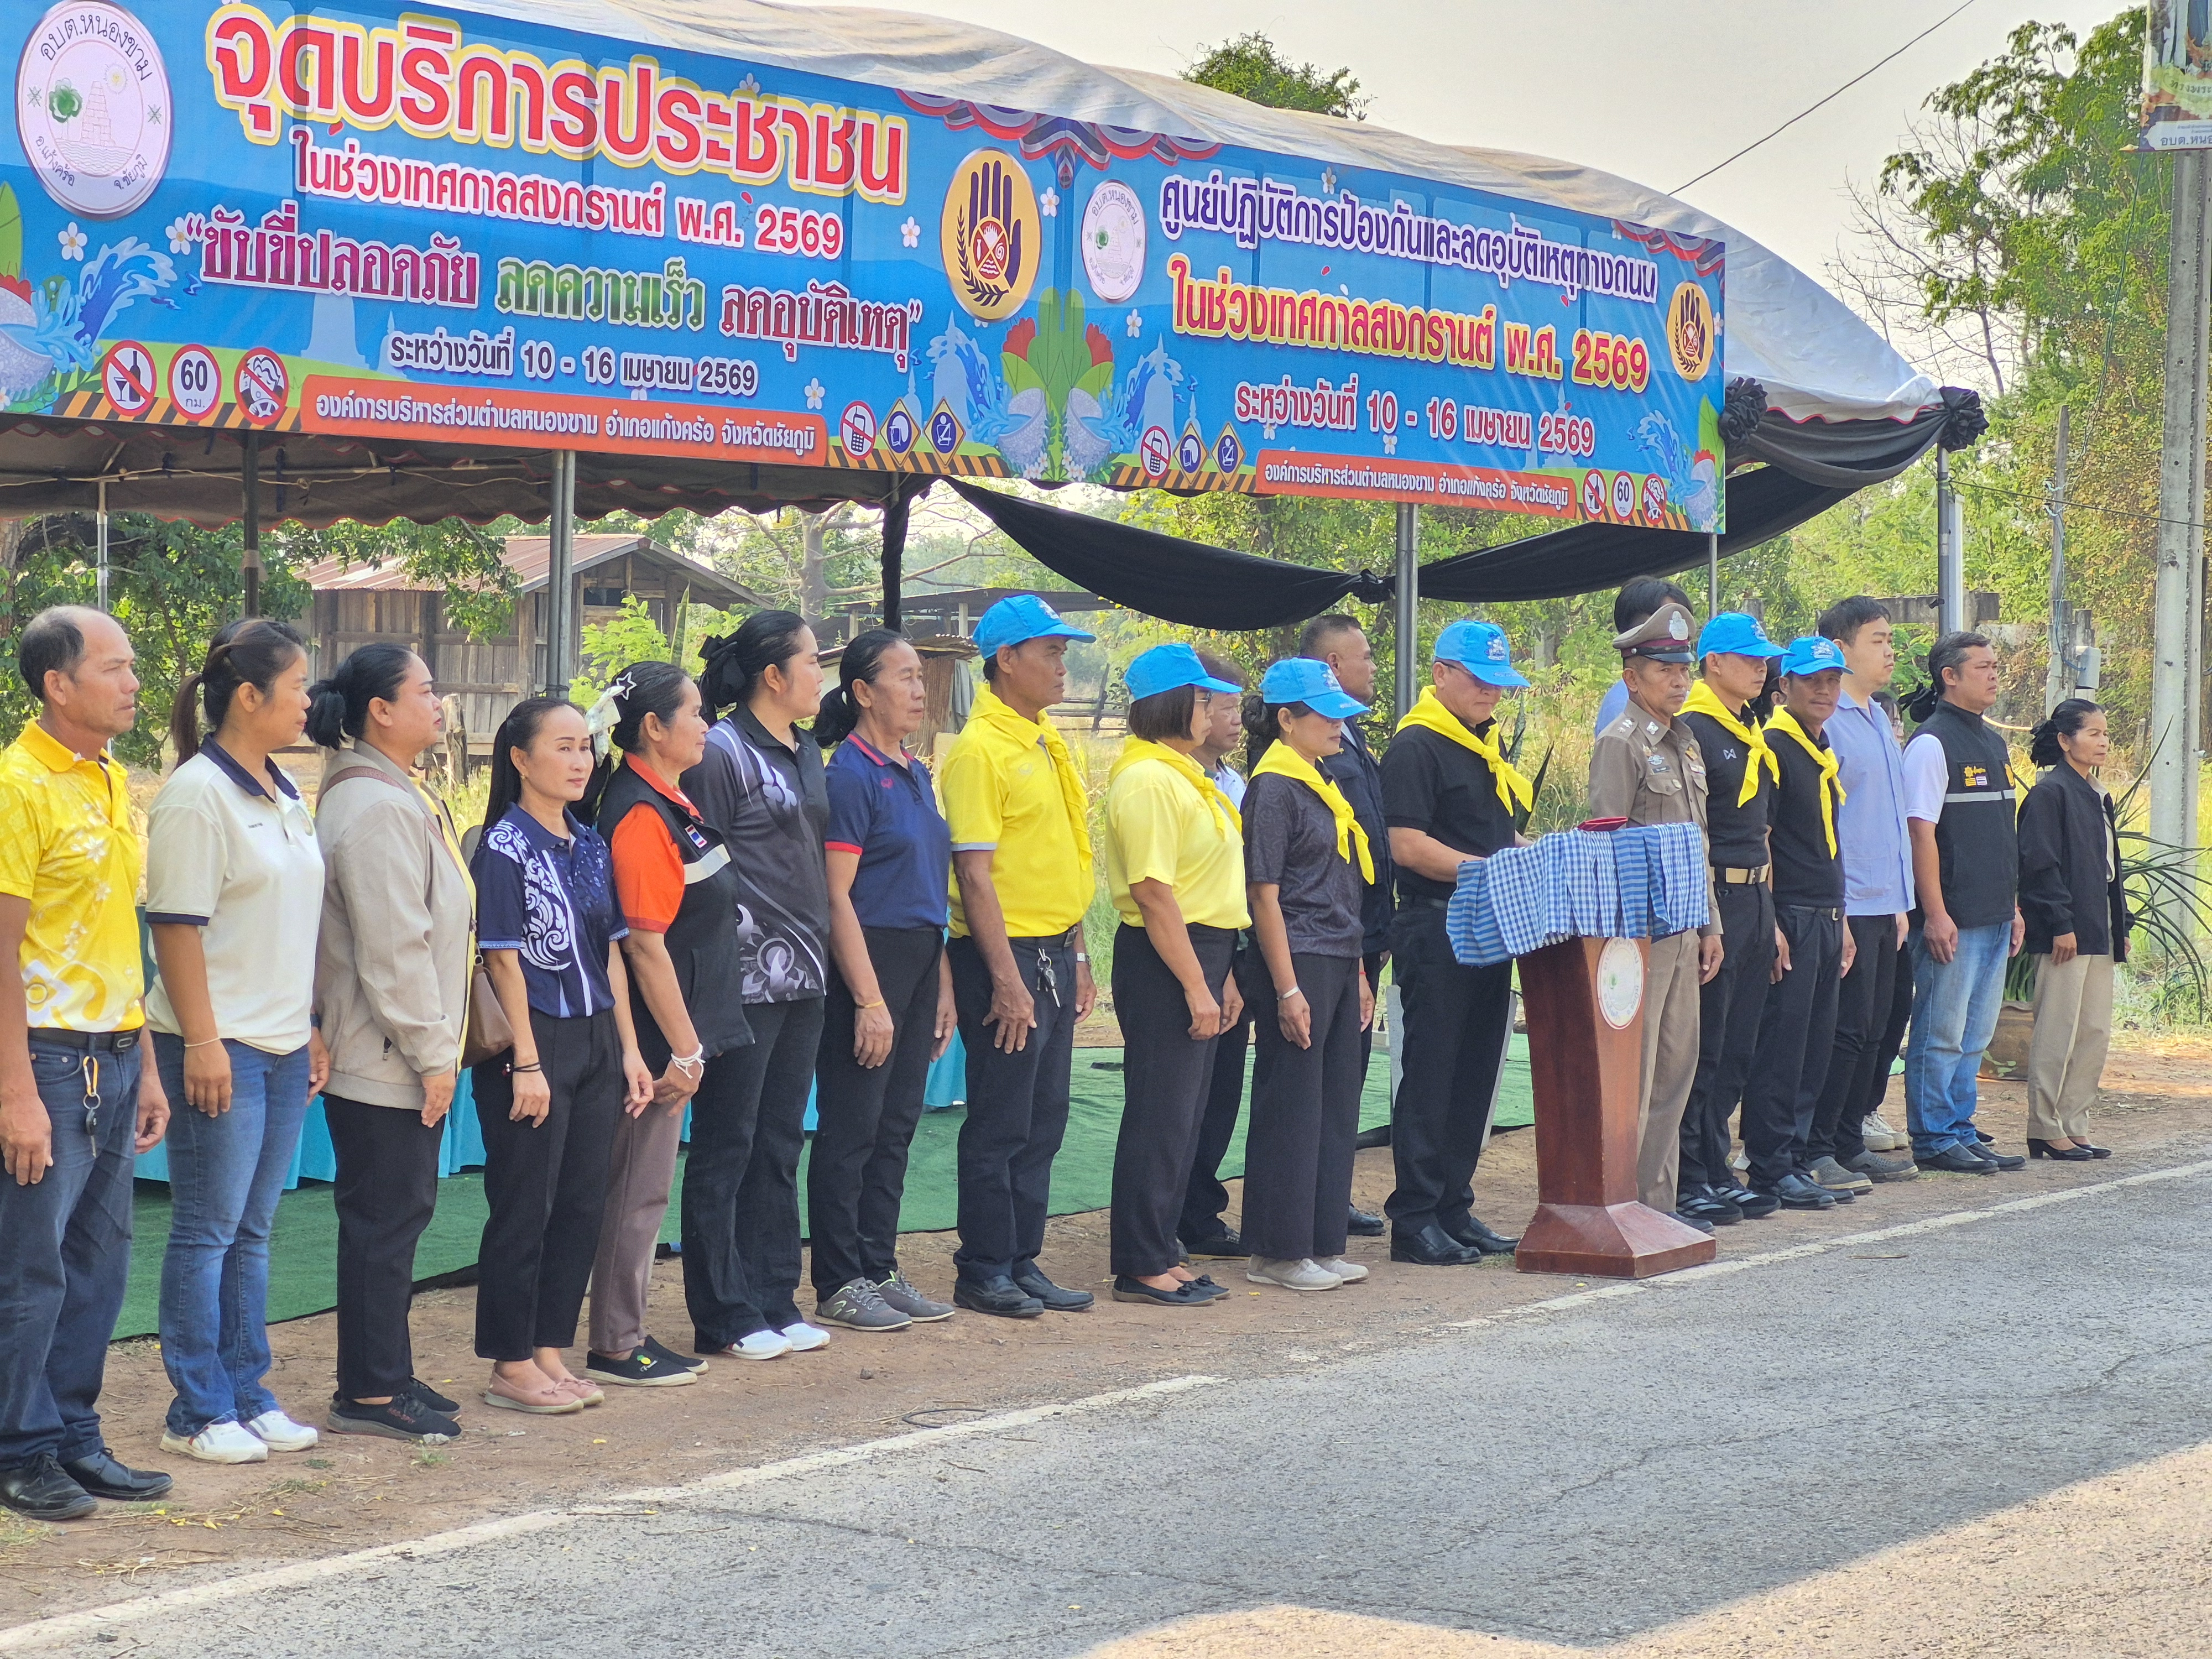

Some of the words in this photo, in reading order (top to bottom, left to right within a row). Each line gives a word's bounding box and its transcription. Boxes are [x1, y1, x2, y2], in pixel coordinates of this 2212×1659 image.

[41, 14, 153, 81] อบต.หนองขาม
[214, 17, 901, 195] จุดบริการประชาชน
[35, 136, 75, 186] อ.แก้งคร้อ
[114, 154, 148, 190] จ.ชัยภูมิ
[293, 130, 665, 233] ในช่วงเทศกาลสงกรานต์
[679, 201, 743, 243] พ.ศ.
[758, 209, 841, 256] 2569
[1162, 175, 1657, 298] ศูนย์ปฏิบัติการป้องกันและลดอุบัติเหตุทางถนน
[186, 204, 477, 305] “ขับขี่ปลอดภัย
[498, 260, 704, 327] ลดความเร็ว
[721, 281, 921, 368] ลดอุบัติเหตุ”
[1172, 260, 1494, 364] ในช่วงเทศกาลสงกรานต์
[1506, 327, 1561, 375] พ.ศ.
[1574, 334, 1647, 388] 2569
[181, 359, 207, 392] 60
[390, 332, 512, 371] ระหว่างวันที่
[524, 344, 552, 375] 10
[585, 349, 612, 381] 16
[624, 357, 690, 385] เมษายน
[700, 361, 755, 393] 2569
[185, 398, 205, 408] กม.
[316, 389, 598, 435] องค์การบริหารส่วนตำบลหนองขาม
[605, 409, 715, 442] อำเภอแก้งคร้อ
[721, 418, 815, 456] จังหวัดชัยภูมิ
[1237, 377, 1358, 426] ระหว่างวันที่
[1368, 394, 1396, 430] 10
[1427, 400, 1455, 436] 16
[1465, 409, 1531, 445] เมษายน
[1540, 415, 1594, 453] 2569
[1265, 460, 1435, 492] องค์การบริหารส่วนตำบลหนองขาม
[1438, 471, 1506, 498] อำเภอแก้งคร้อ
[1510, 480, 1568, 511] จังหวัดชัยภูมิ
[1617, 481, 1630, 502] 60
